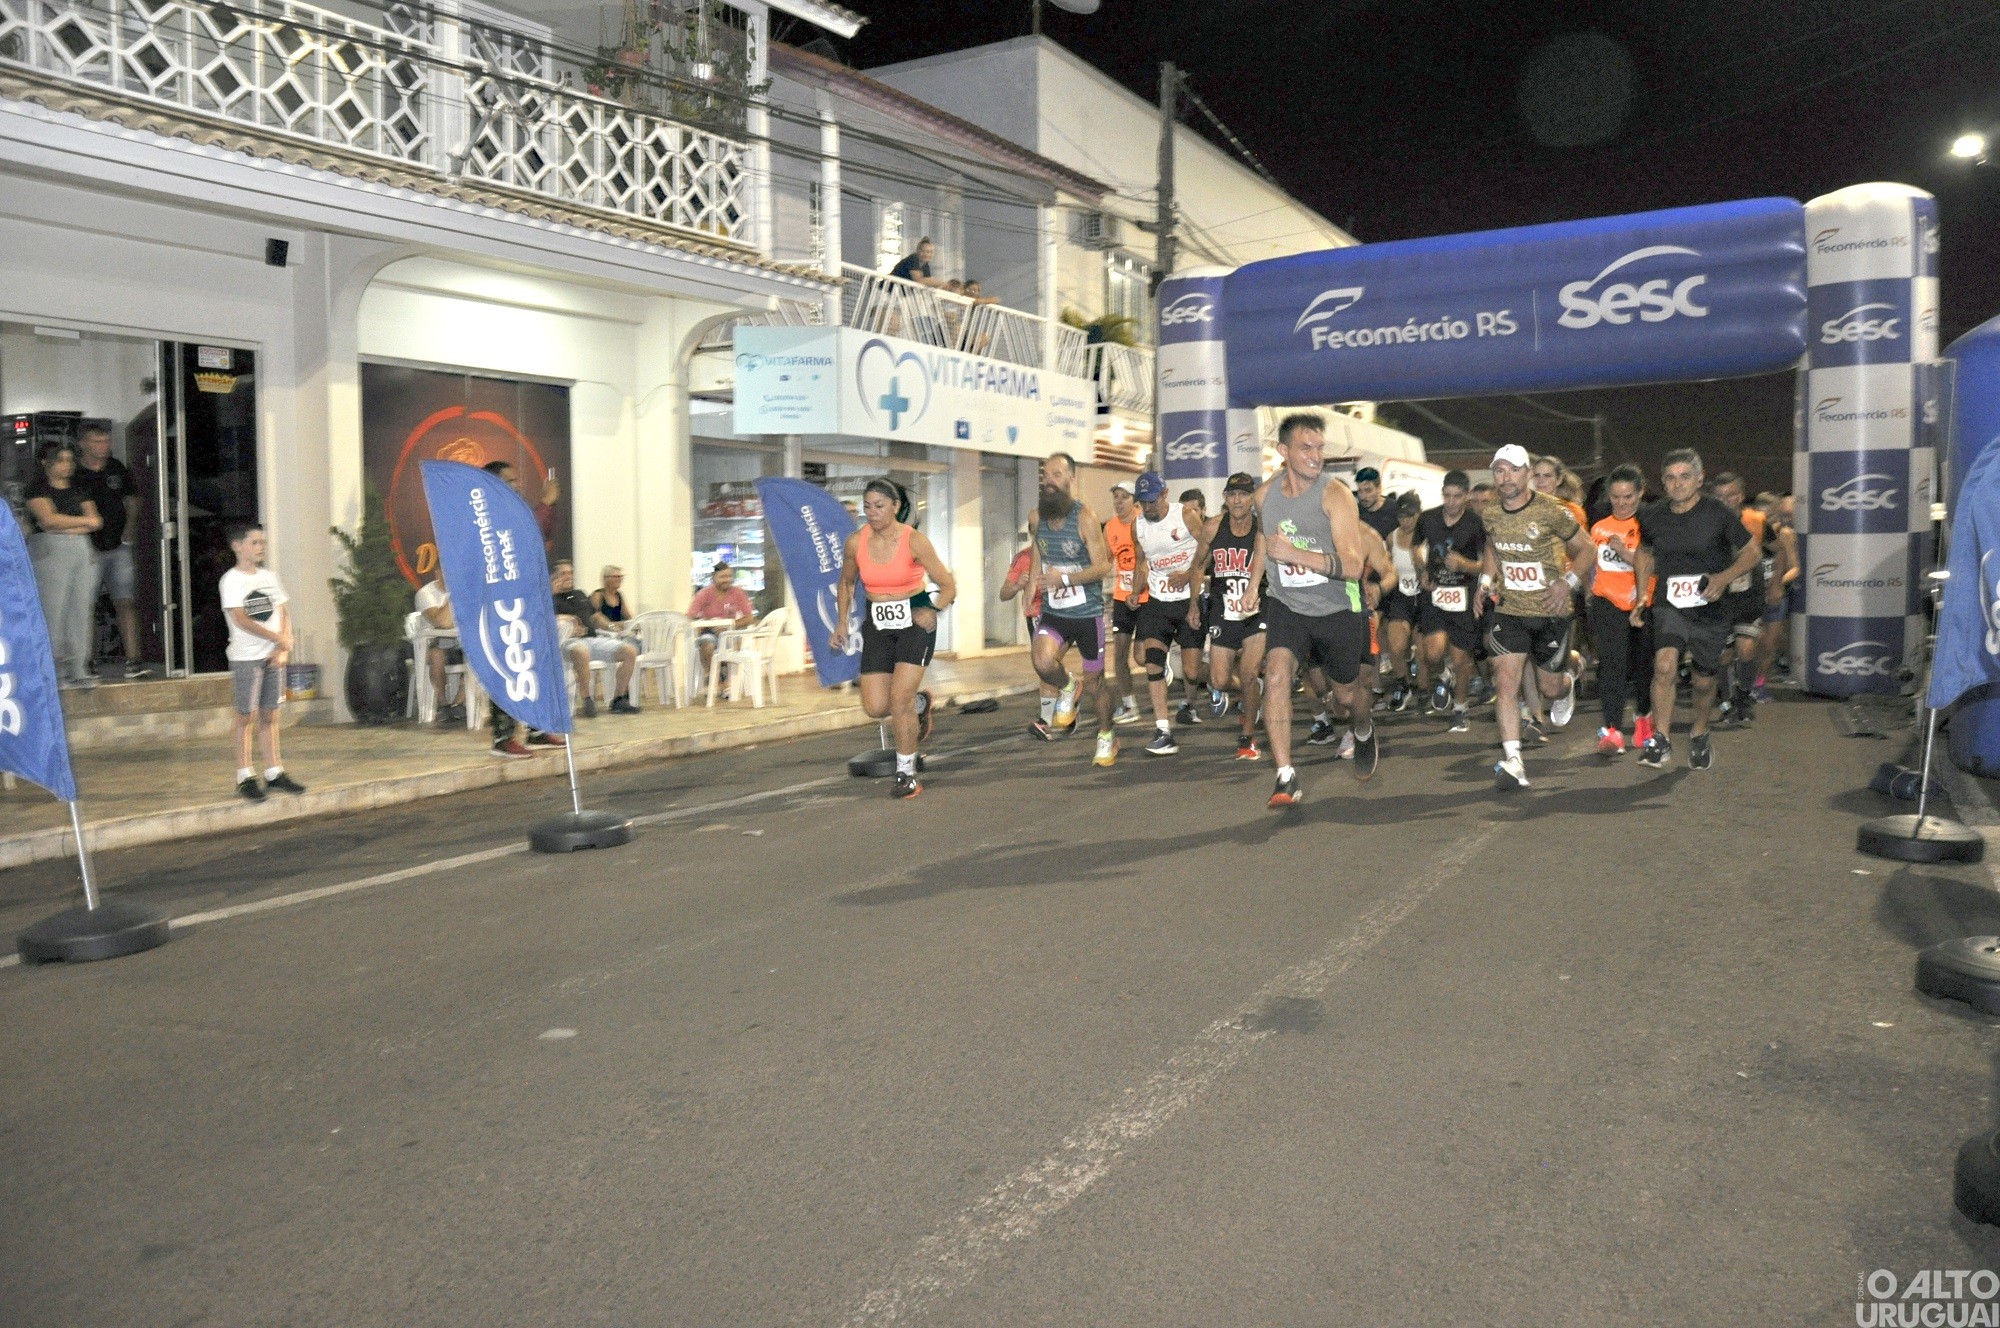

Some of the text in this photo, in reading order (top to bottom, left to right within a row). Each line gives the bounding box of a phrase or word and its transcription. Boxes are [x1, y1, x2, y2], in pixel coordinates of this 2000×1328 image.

[1819, 237, 1887, 254] Fecomércio
[1311, 310, 1517, 351] Fecomércio RS
[927, 352, 1041, 401] VITAFARMA
[469, 488, 499, 584] Fecomércio
[1506, 566, 1537, 581] 300
[1436, 590, 1461, 604] 268
[875, 604, 905, 621] 863
